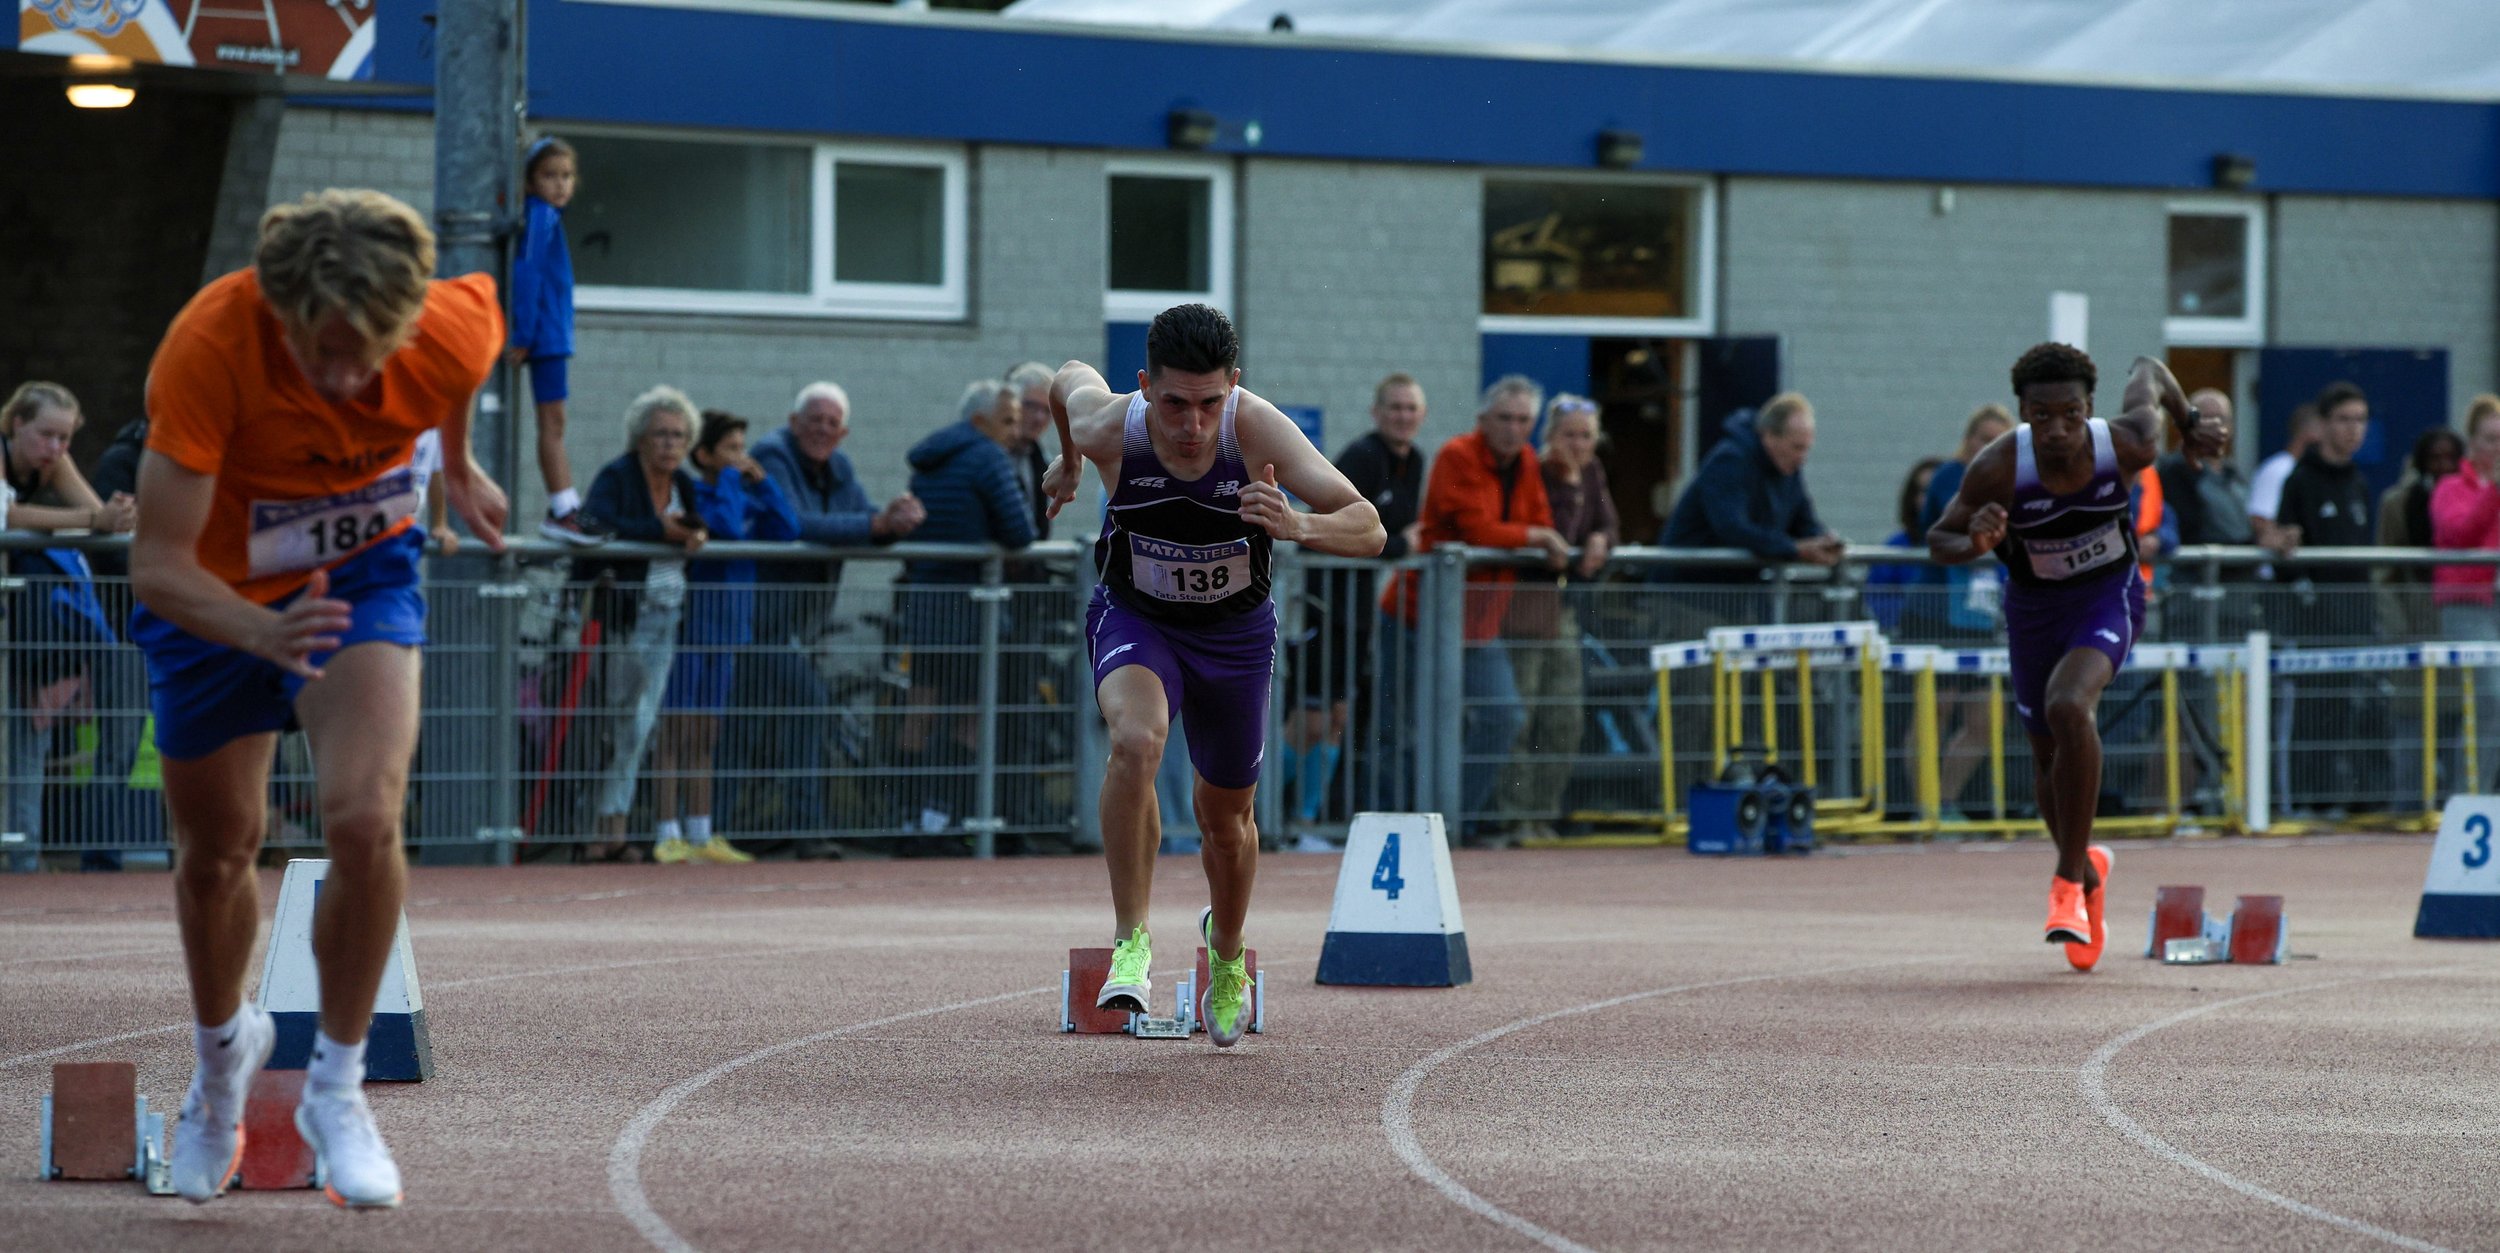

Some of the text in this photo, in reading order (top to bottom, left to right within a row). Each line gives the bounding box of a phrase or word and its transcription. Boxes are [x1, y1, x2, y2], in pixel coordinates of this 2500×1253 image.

[1138, 540, 1239, 560] TATA STEEL
[2064, 542, 2107, 570] 185
[1172, 566, 1230, 593] 138
[1153, 589, 1230, 602] Tata Steel Run
[2462, 813, 2492, 869] 3
[1372, 833, 1405, 901] 4
